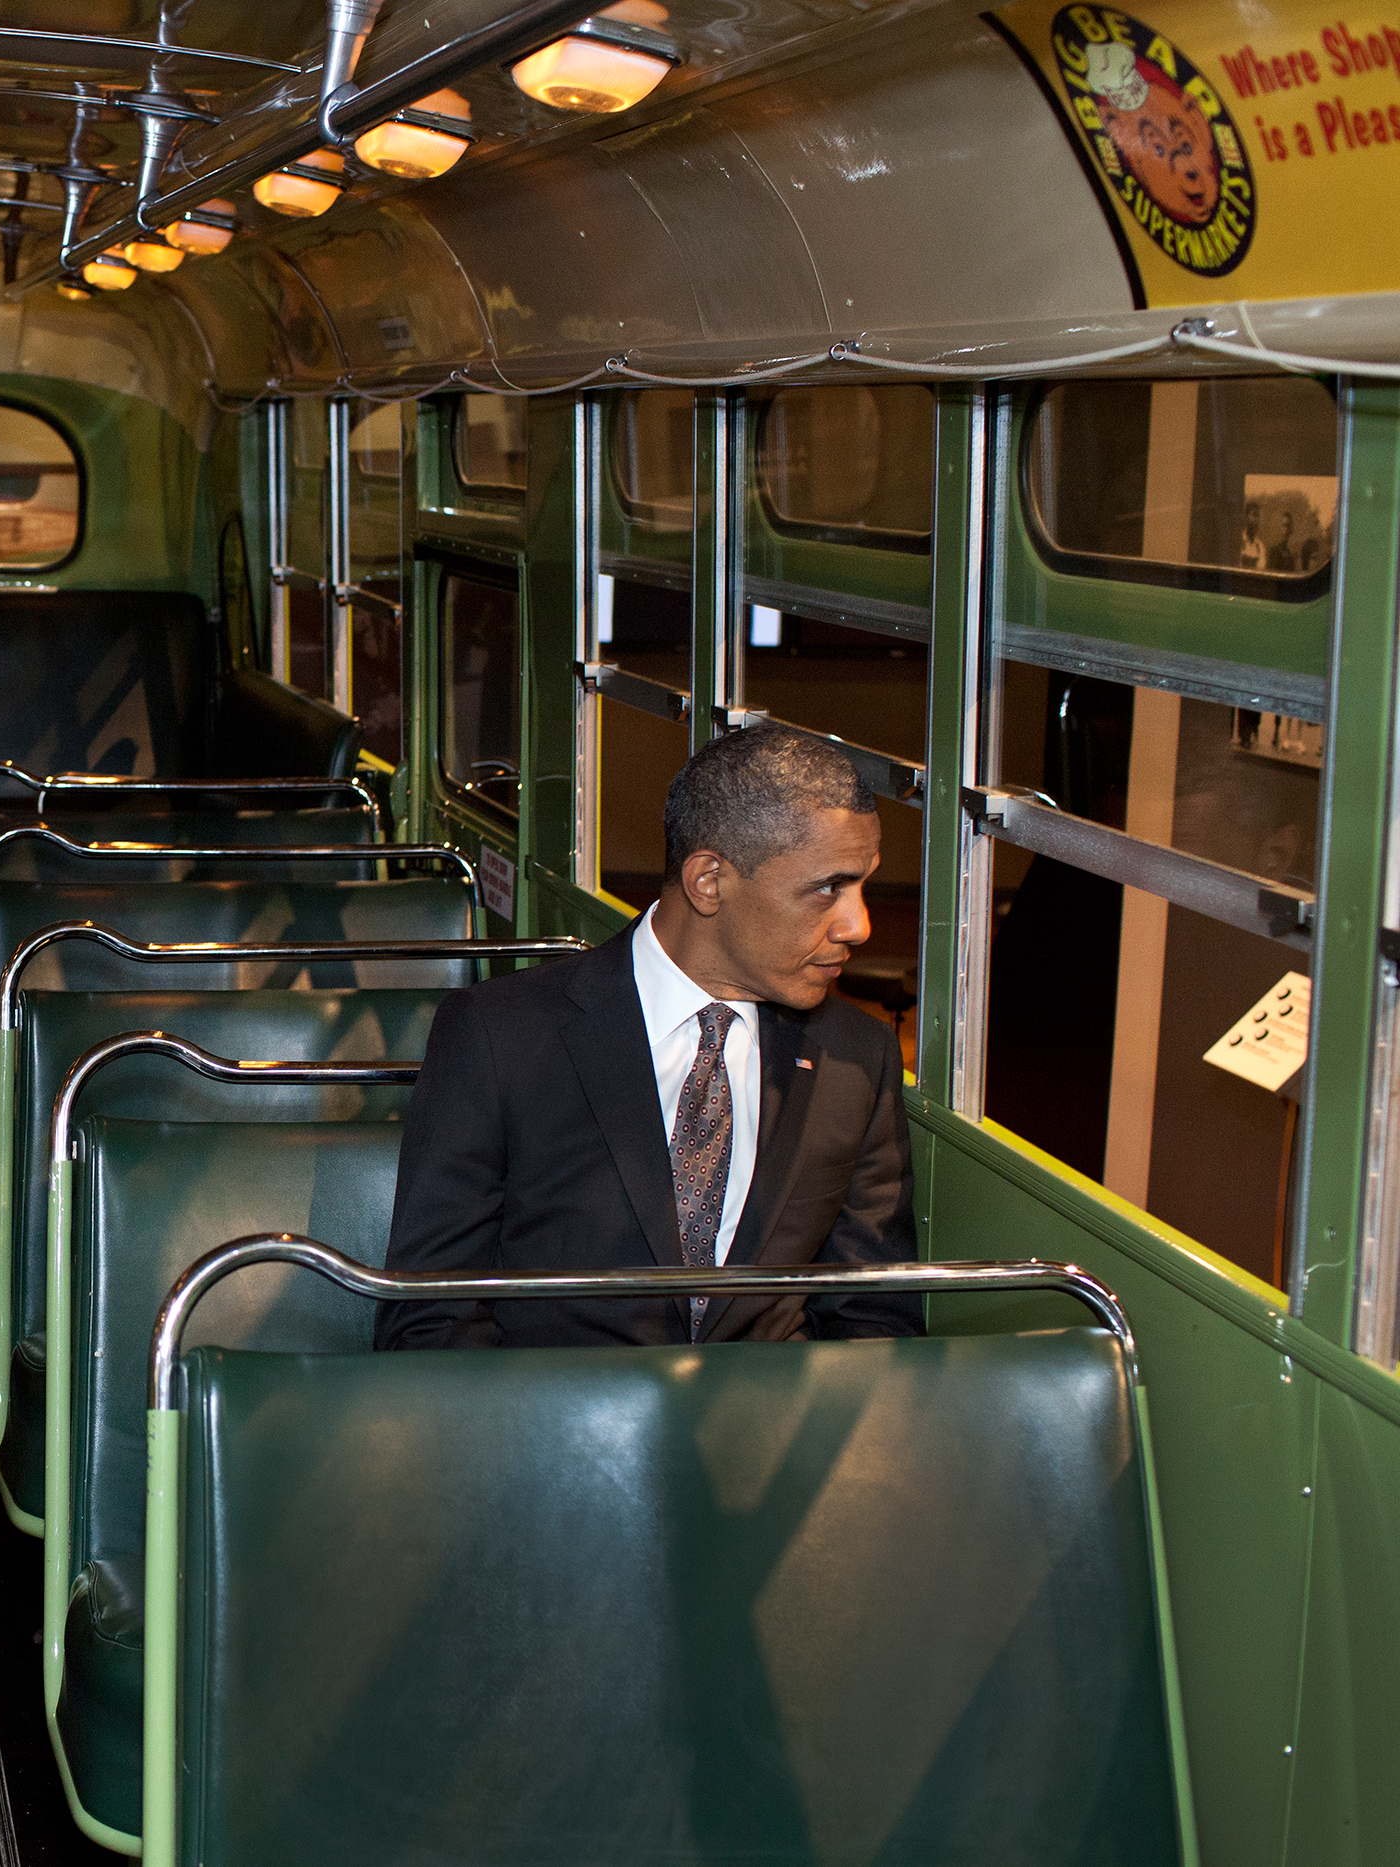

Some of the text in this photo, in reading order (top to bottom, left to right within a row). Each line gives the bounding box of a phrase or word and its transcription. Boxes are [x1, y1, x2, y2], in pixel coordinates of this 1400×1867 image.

[1054, 6, 1222, 129] BIG BEAR
[1219, 45, 1321, 99] Where
[1254, 115, 1288, 162] is
[1294, 121, 1315, 157] a
[1121, 168, 1250, 268] SUPERMARKETS
